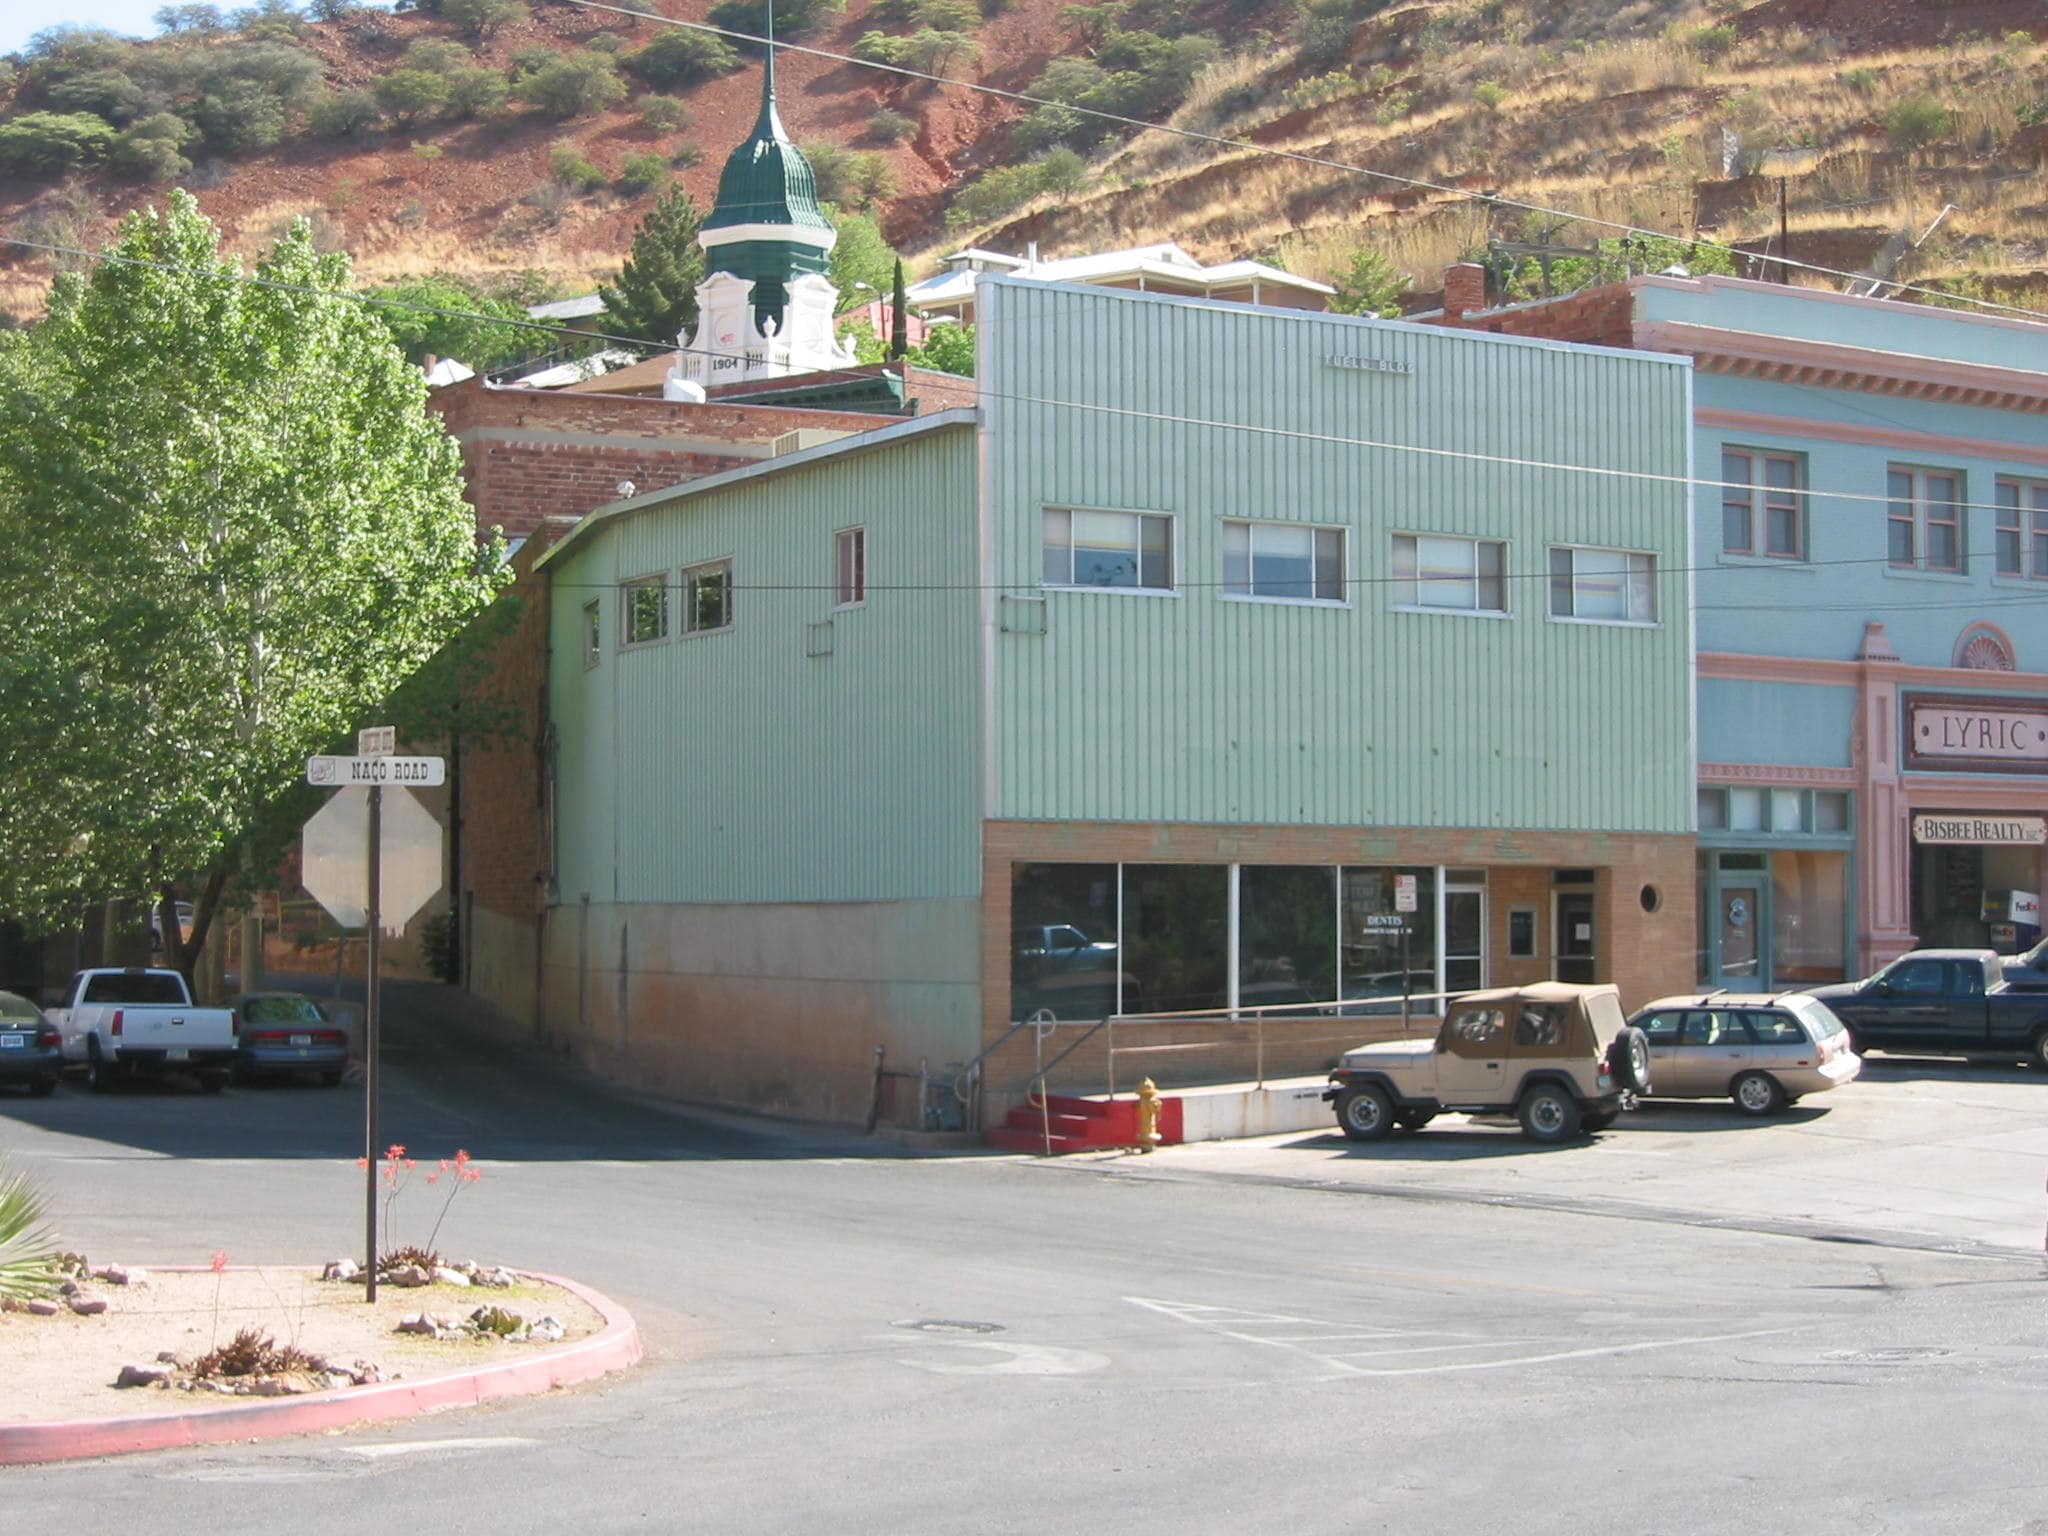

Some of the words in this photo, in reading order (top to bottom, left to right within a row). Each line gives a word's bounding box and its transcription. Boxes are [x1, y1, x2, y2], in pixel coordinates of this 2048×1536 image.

[713, 357, 737, 370] 1904
[1943, 716, 2028, 750] LYRIC
[394, 762, 428, 780] ROAD
[1924, 818, 1971, 840] BISBEE
[1973, 820, 2025, 841] REALTY
